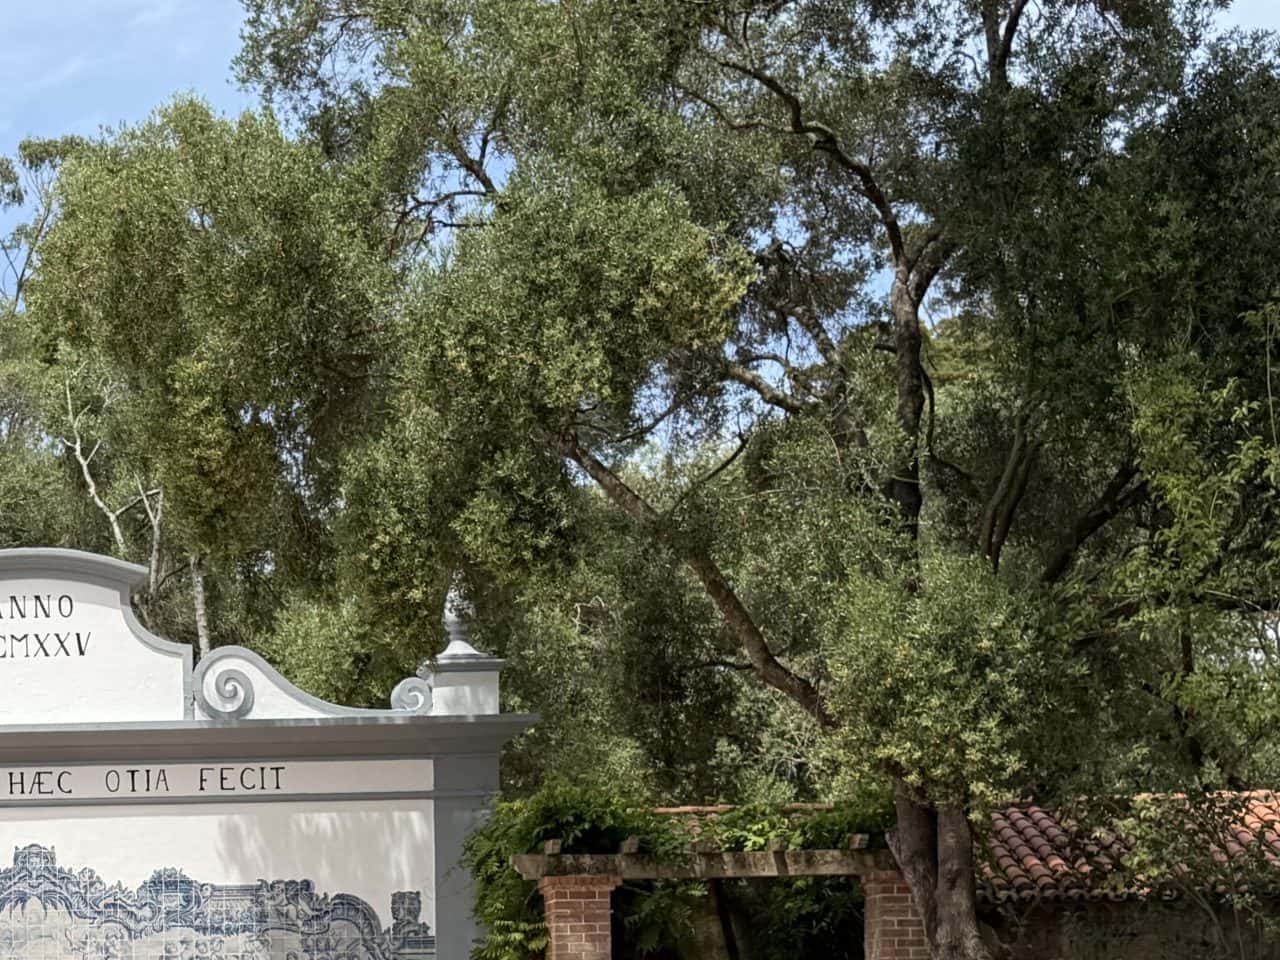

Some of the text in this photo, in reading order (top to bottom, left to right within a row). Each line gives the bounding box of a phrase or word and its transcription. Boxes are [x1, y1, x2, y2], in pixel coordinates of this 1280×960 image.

[7, 771, 72, 795] HÆC
[105, 769, 169, 792] OTIA
[199, 766, 285, 791] FECIT
